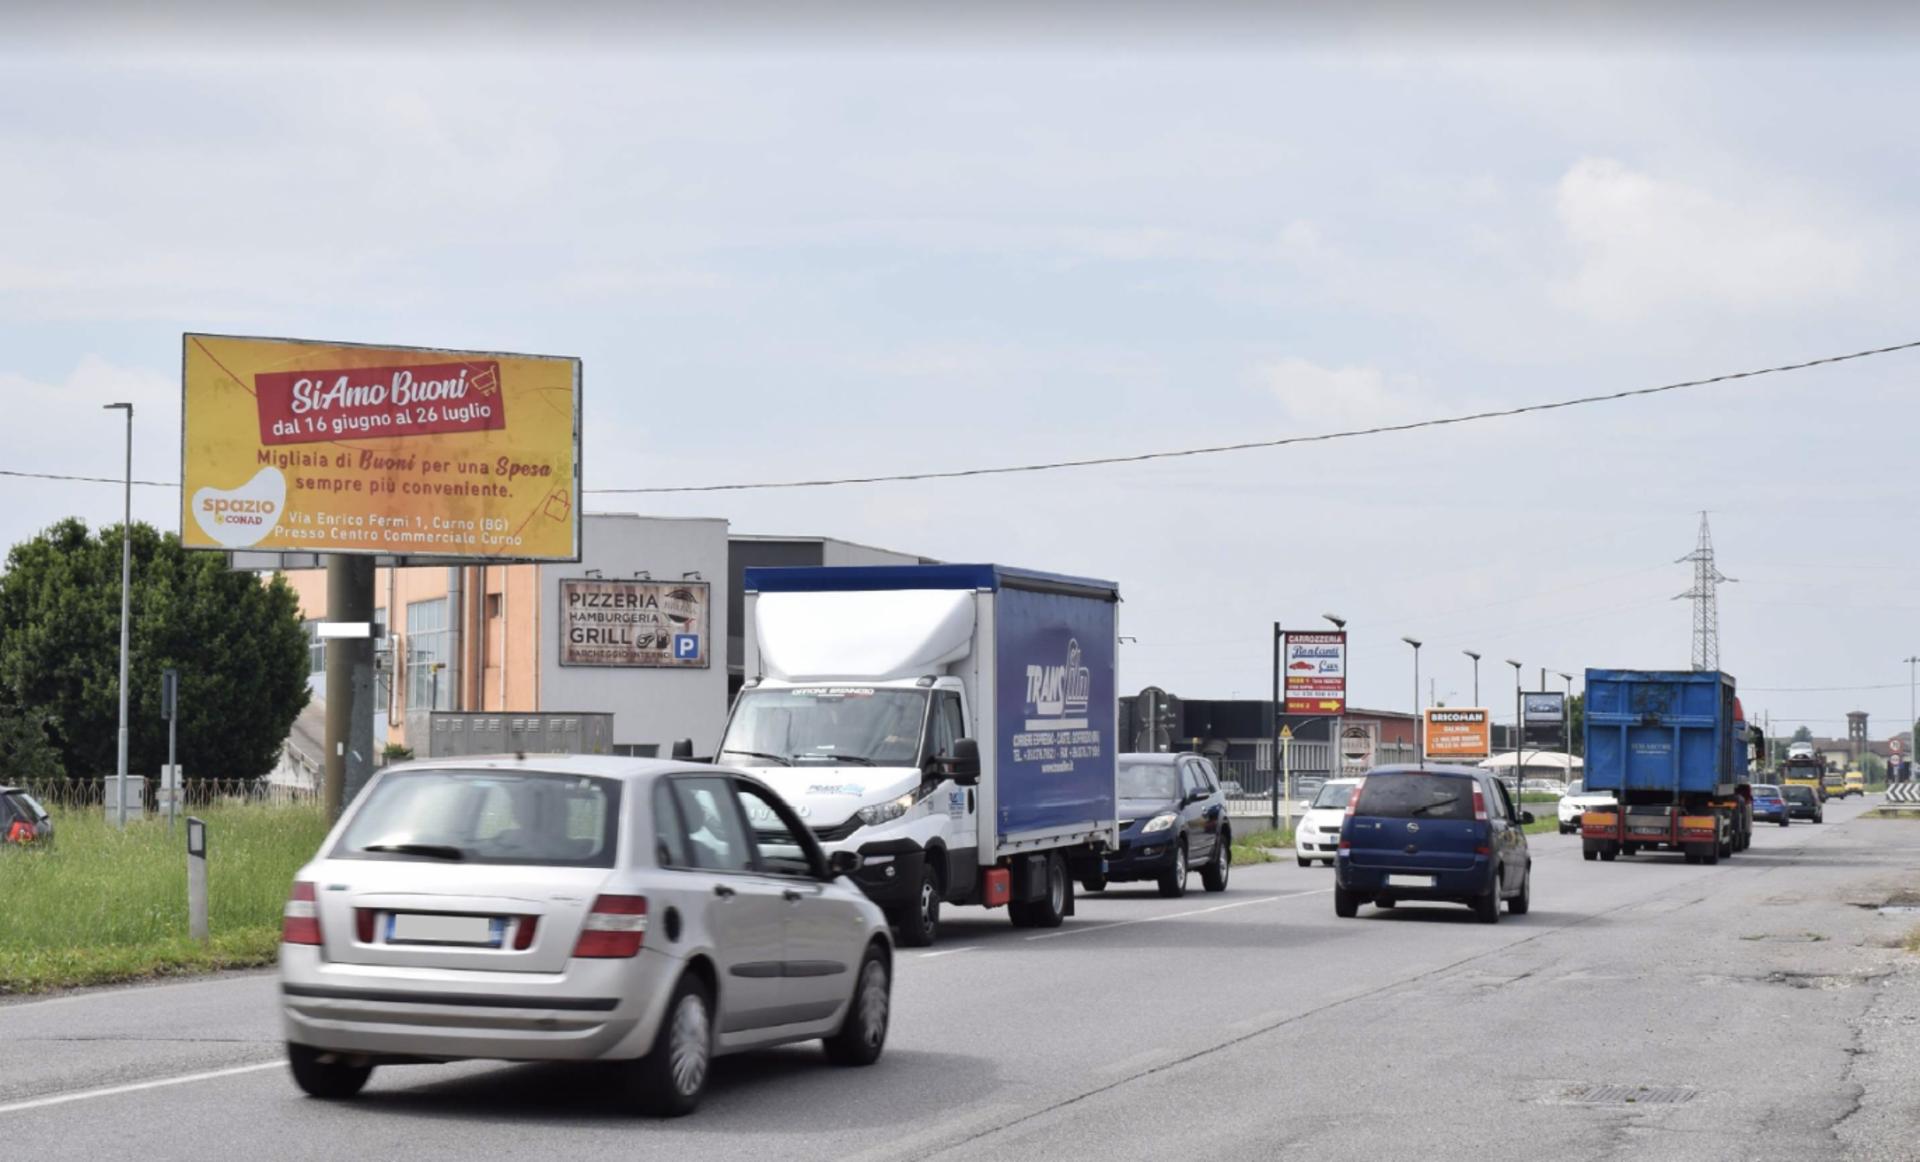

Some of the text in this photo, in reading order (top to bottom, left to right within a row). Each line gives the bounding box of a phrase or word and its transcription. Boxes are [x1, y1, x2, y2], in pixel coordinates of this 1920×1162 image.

[291, 369, 469, 414] SiAmo Buoni
[273, 402, 491, 436] dal 16 giugno al 26 luglio
[257, 449, 552, 482] Migliaia di Buoni per una Spesa
[295, 476, 513, 498] sempre più conveniente.
[202, 498, 275, 515] spazio
[225, 514, 263, 526] CONAD
[289, 510, 509, 532] Via Enrico Fermi 1, Curno (BG)
[274, 525, 522, 546] Presso Centro Commerciale Curno
[569, 592, 659, 609] PIZZERIA
[569, 612, 660, 624] HAMBURGERIA
[569, 627, 633, 645] GRILL
[1288, 635, 1343, 644] CARROZZERIA
[679, 638, 695, 657] P
[1431, 713, 1483, 722] BRICOMAN
